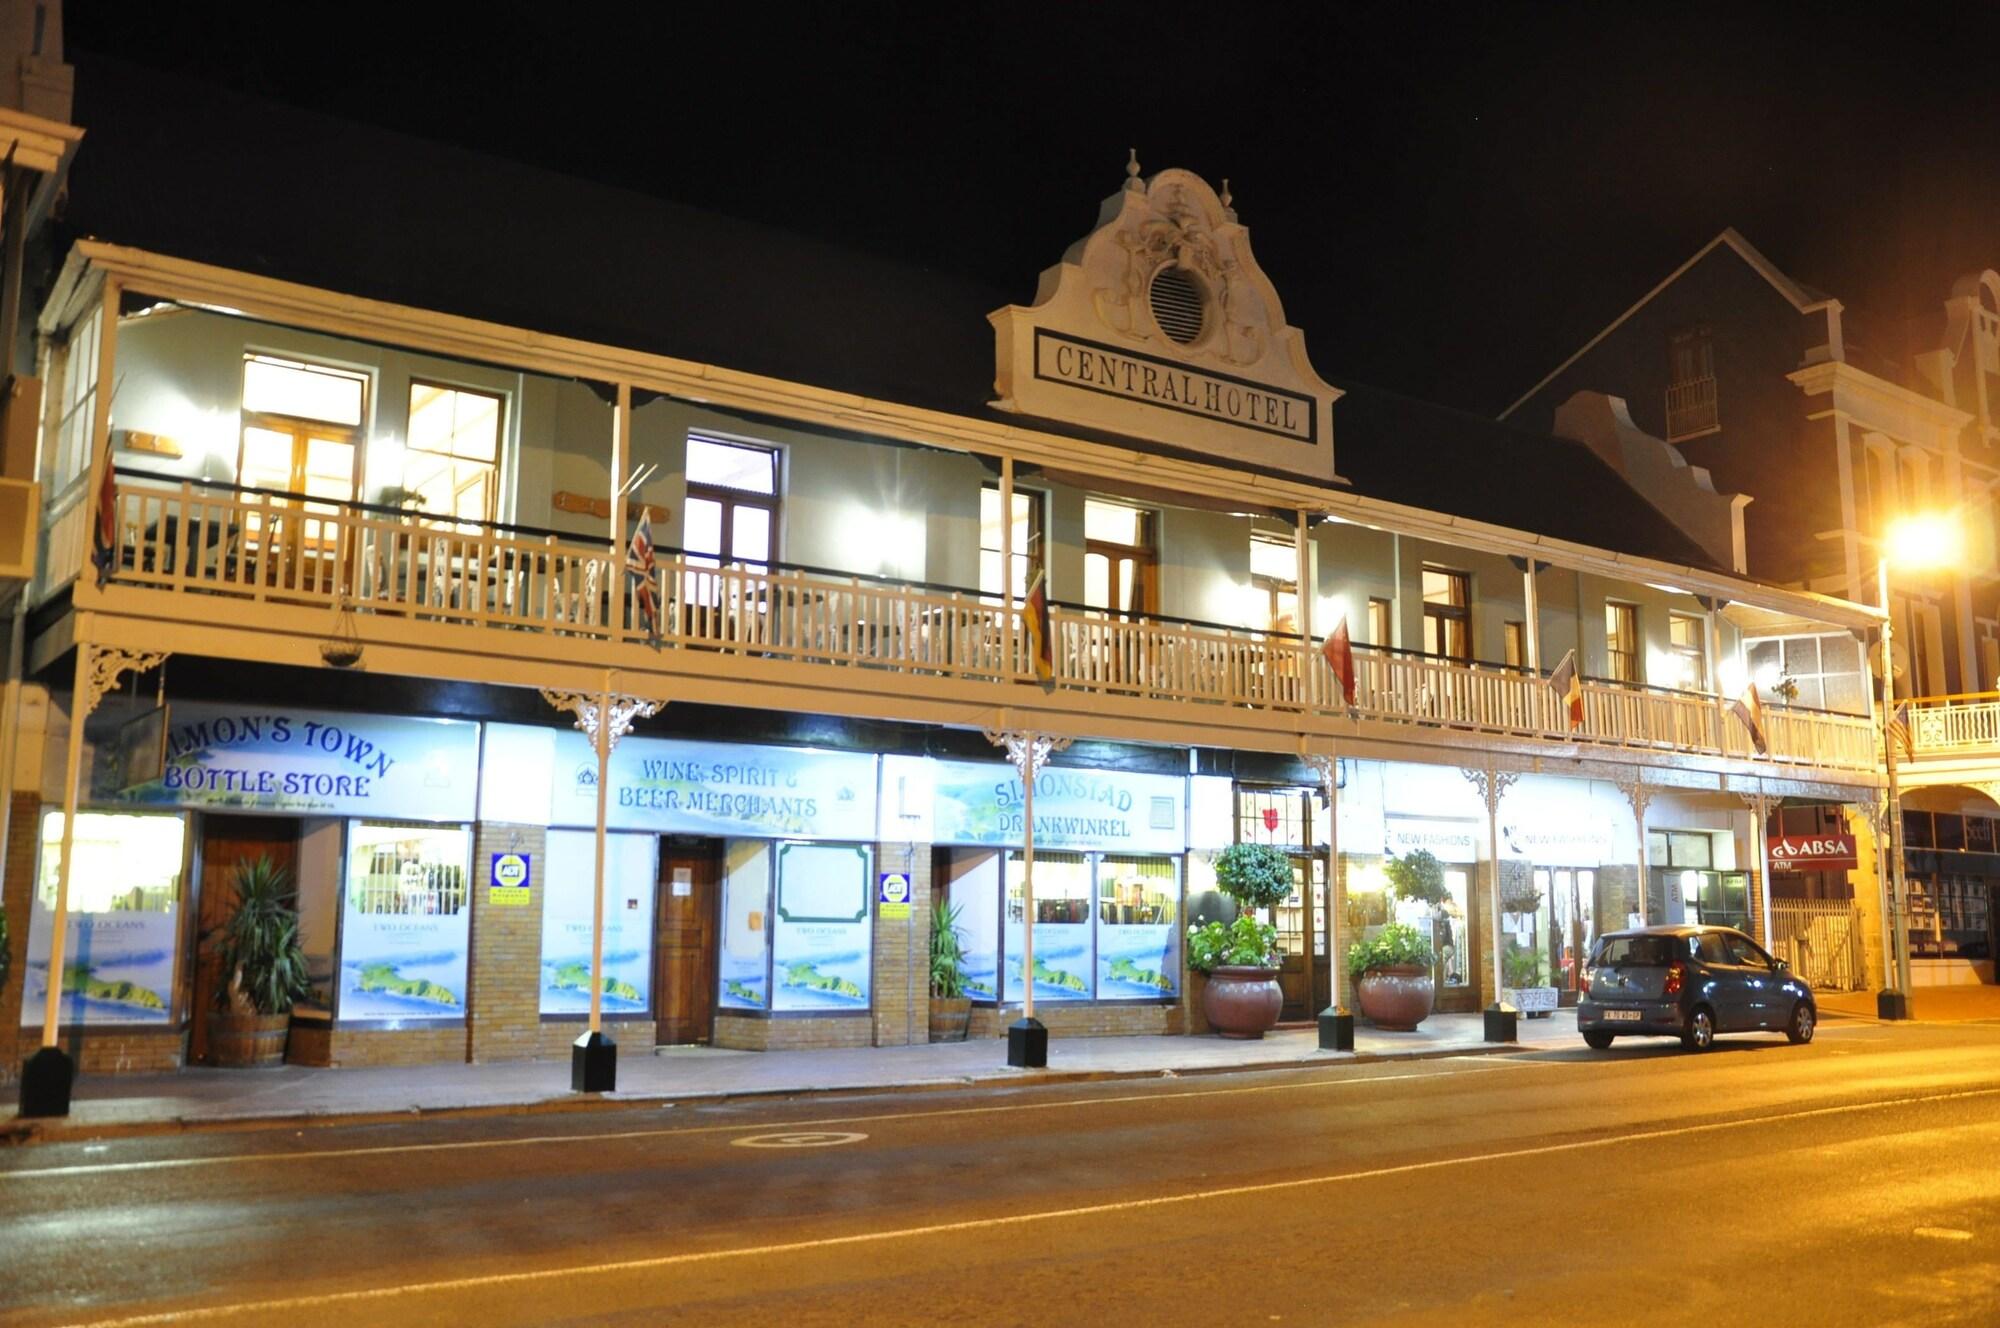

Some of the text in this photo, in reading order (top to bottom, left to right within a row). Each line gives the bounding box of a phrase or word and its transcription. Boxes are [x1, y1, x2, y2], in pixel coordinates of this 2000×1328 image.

[1056, 345, 1297, 430] CENTRAL HOTEL
[165, 716, 396, 779] IMON'S TOWN
[163, 766, 371, 797] BOTTLE STORE
[712, 764, 781, 787] SPIRIT
[619, 786, 679, 809] BEER
[685, 790, 818, 818] MERCHANTS
[1397, 832, 1471, 847] NEW FASHIONS
[1799, 840, 1849, 855] ABSA
[501, 865, 519, 876] ADT
[1773, 861, 1792, 871] ATM
